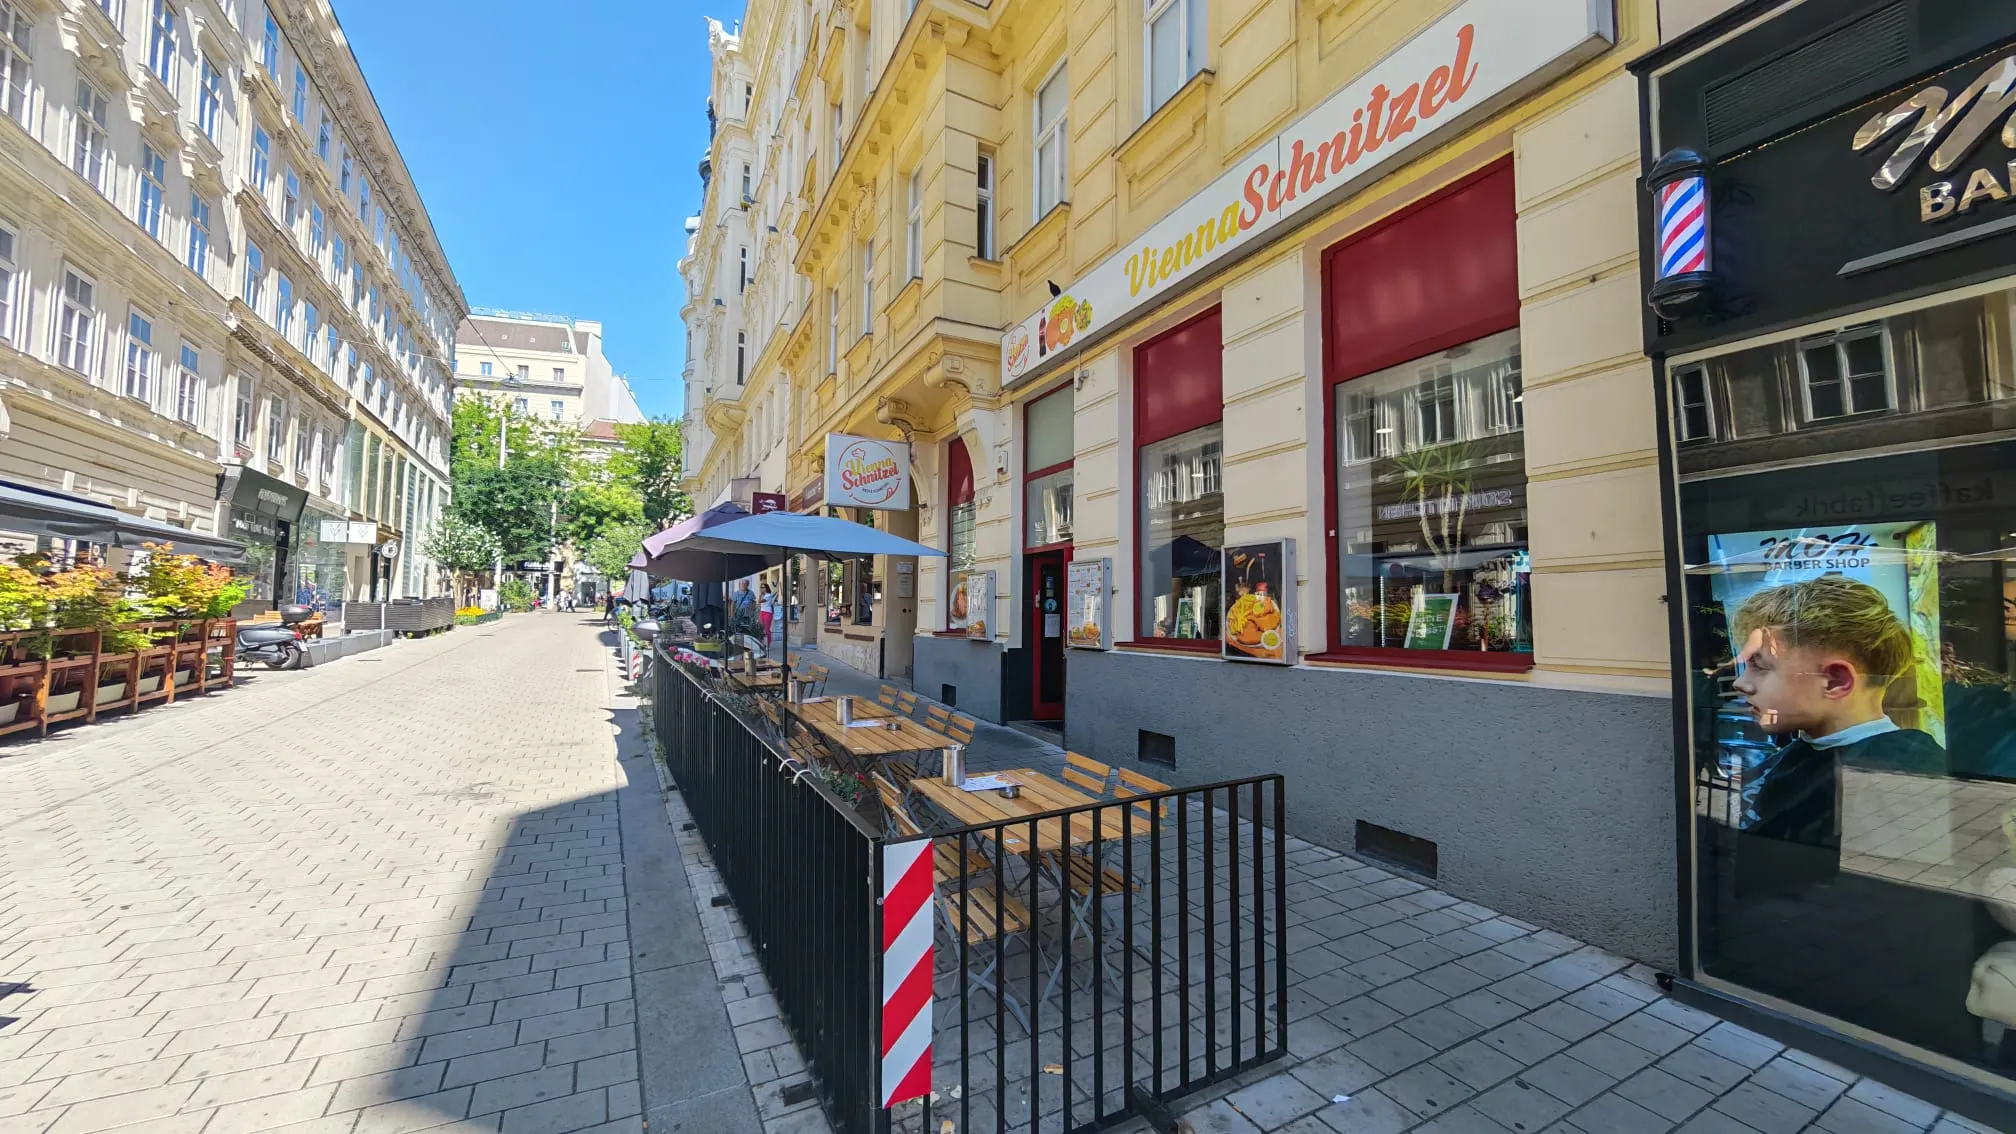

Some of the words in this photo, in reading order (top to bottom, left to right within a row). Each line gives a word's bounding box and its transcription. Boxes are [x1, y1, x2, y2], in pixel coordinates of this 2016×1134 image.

[841, 461, 900, 491] Schnitzel
[845, 457, 893, 476] Vienna
[1764, 560, 1822, 572] BARBER
[1826, 558, 1870, 570] SHOP
